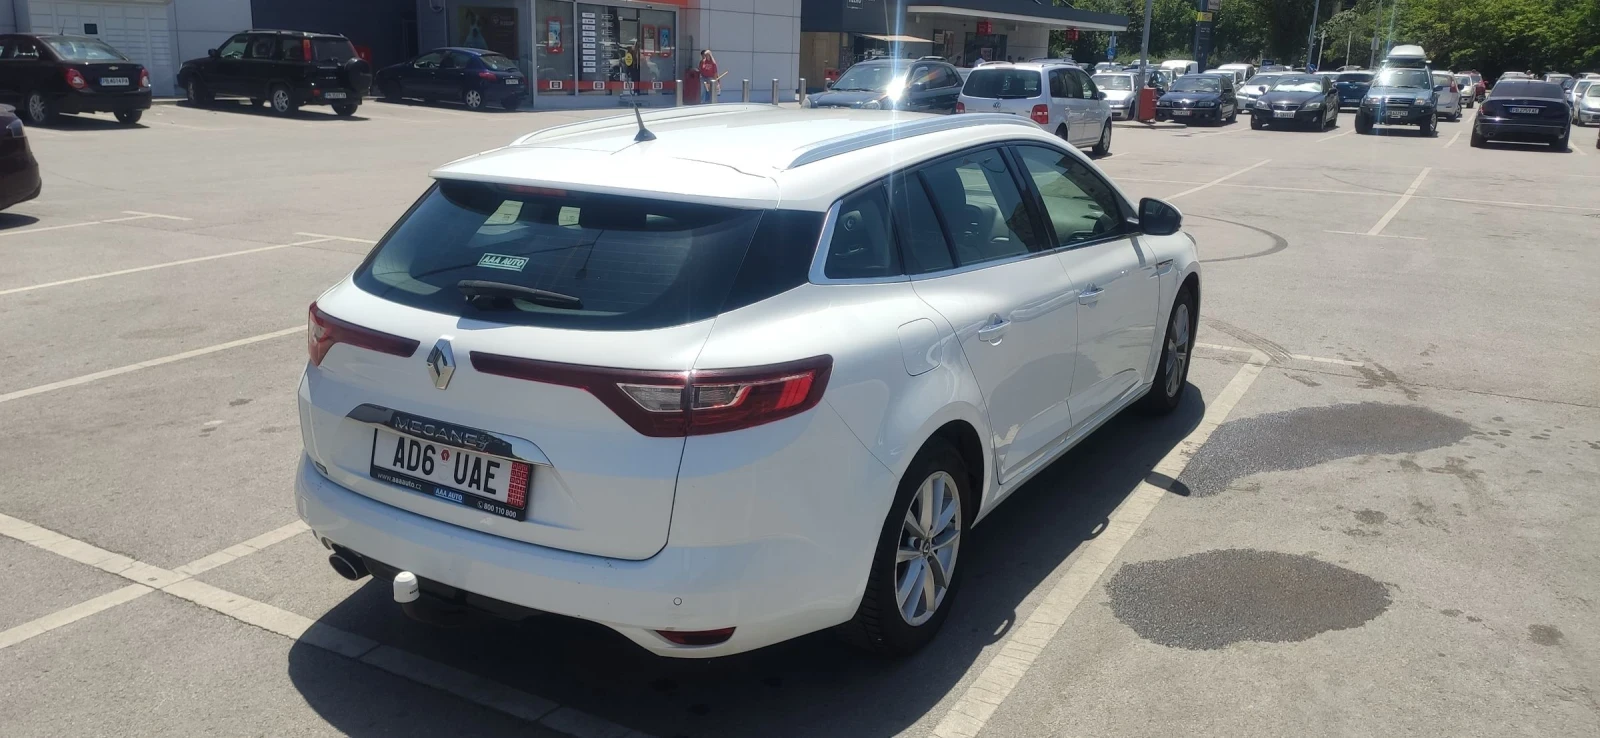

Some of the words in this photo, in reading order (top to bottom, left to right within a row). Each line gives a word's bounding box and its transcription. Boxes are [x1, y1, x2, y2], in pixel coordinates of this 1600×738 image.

[482, 255, 501, 264] AAA
[501, 257, 525, 267] AUTO
[394, 416, 478, 447] MEGANE
[392, 436, 436, 476] AD6
[453, 451, 501, 495] UAE
[377, 473, 422, 490] www.aaaauto.cz
[435, 487, 447, 498] AAA
[447, 489, 463, 501] AUTO
[483, 502, 495, 512] 800
[495, 505, 505, 515] 110
[505, 510, 517, 518] 800
